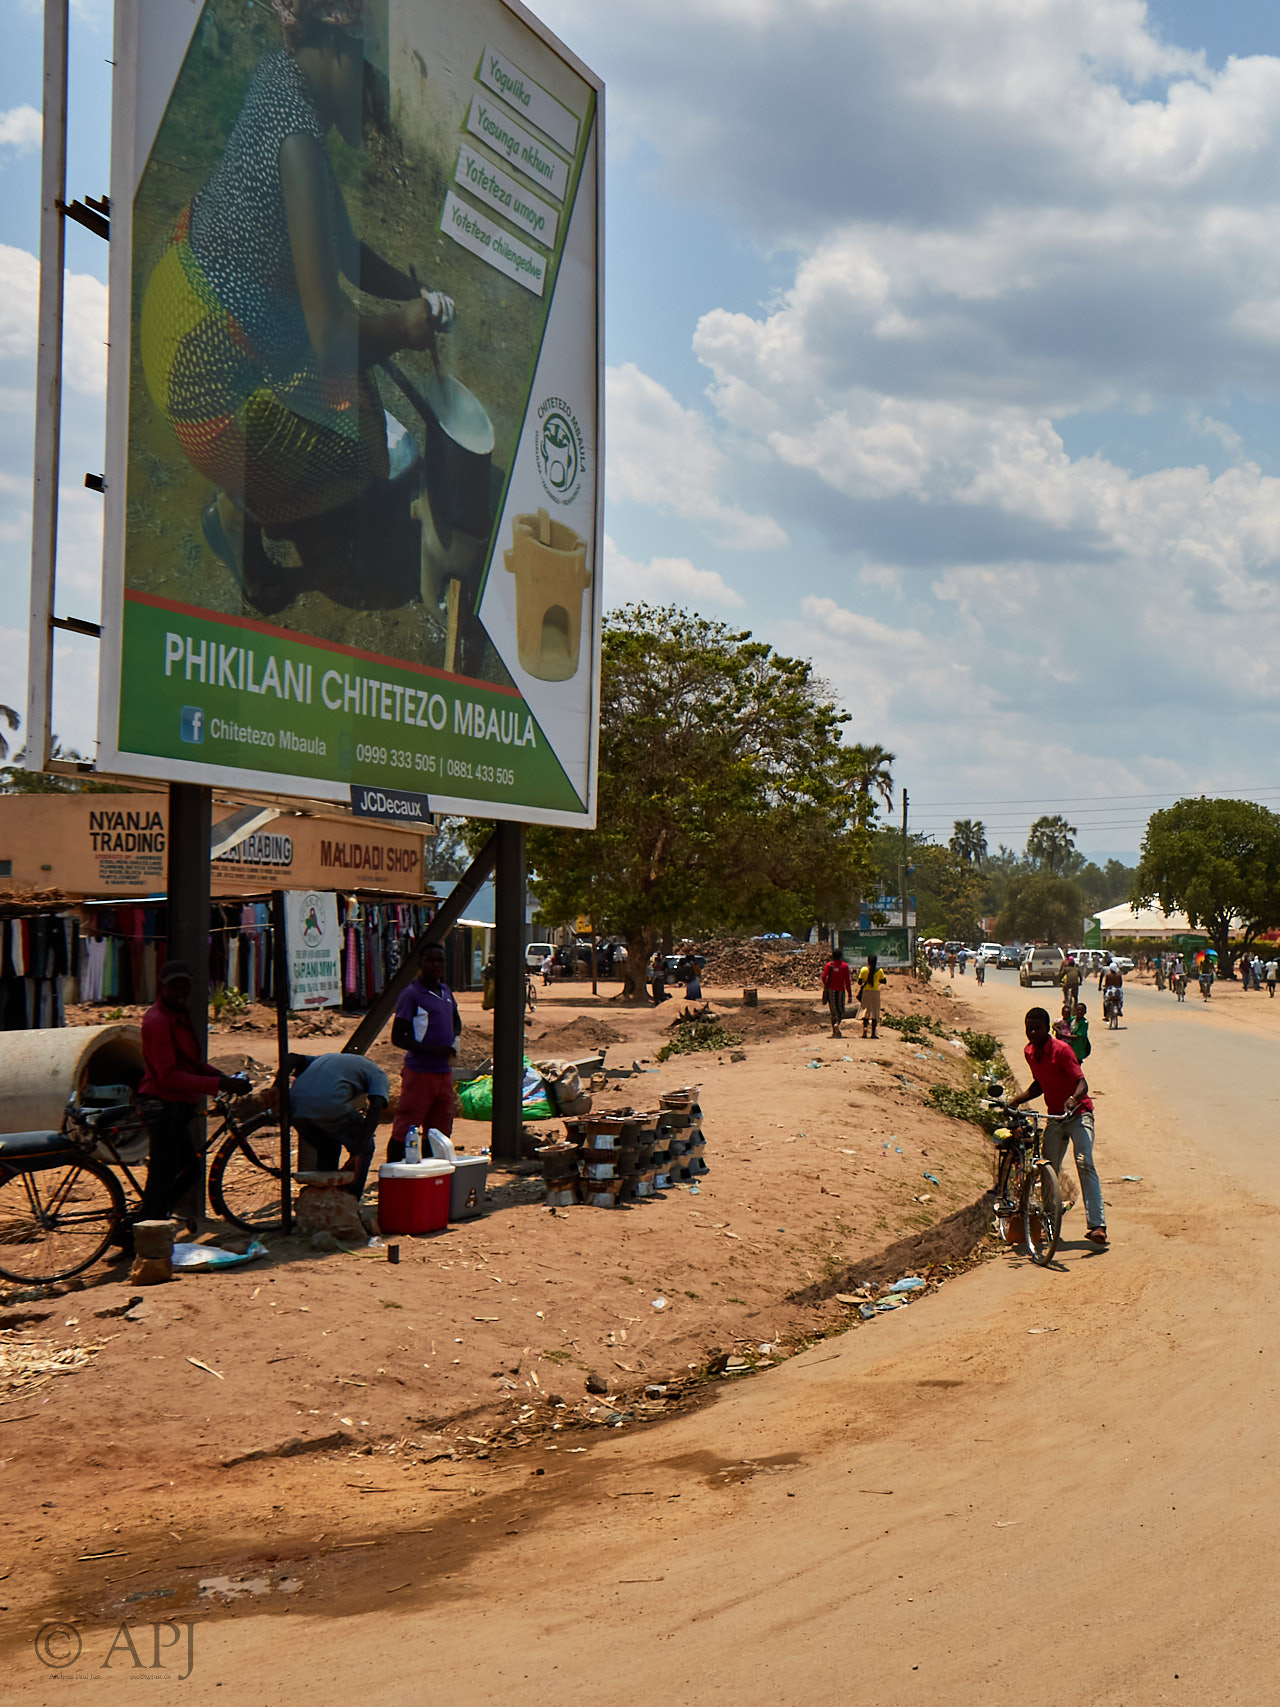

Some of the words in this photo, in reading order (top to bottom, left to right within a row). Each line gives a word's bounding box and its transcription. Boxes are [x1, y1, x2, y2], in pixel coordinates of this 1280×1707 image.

[490, 56, 531, 107] Yogulika
[477, 104, 520, 156] Yosunga
[521, 144, 555, 181] nkhuni
[465, 156, 511, 207] Yoteteza
[513, 197, 546, 231] umoyo
[451, 205, 491, 247] Yoteteza
[491, 235, 543, 281] chilengedwe
[537, 397, 572, 419] CHITETEZO
[570, 415, 586, 473] MBAULA
[165, 632, 312, 704] PHIKILANI
[321, 669, 447, 730] CHITETEZO
[454, 699, 536, 748] MBAULA
[210, 718, 275, 748] Chitetezo
[279, 729, 327, 756] Mbaula
[356, 743, 387, 765] 0999
[390, 749, 412, 769] 333
[414, 753, 436, 772] 505
[446, 759, 473, 779] 0881
[475, 764, 494, 783] 433
[496, 768, 515, 785] 505
[89, 811, 163, 831] NYANJA
[360, 791, 423, 817] JCDecaux
[89, 832, 165, 853] TRADING
[241, 834, 293, 864] TRADING
[320, 840, 384, 870] MALIDADI
[387, 847, 418, 873] SHOP
